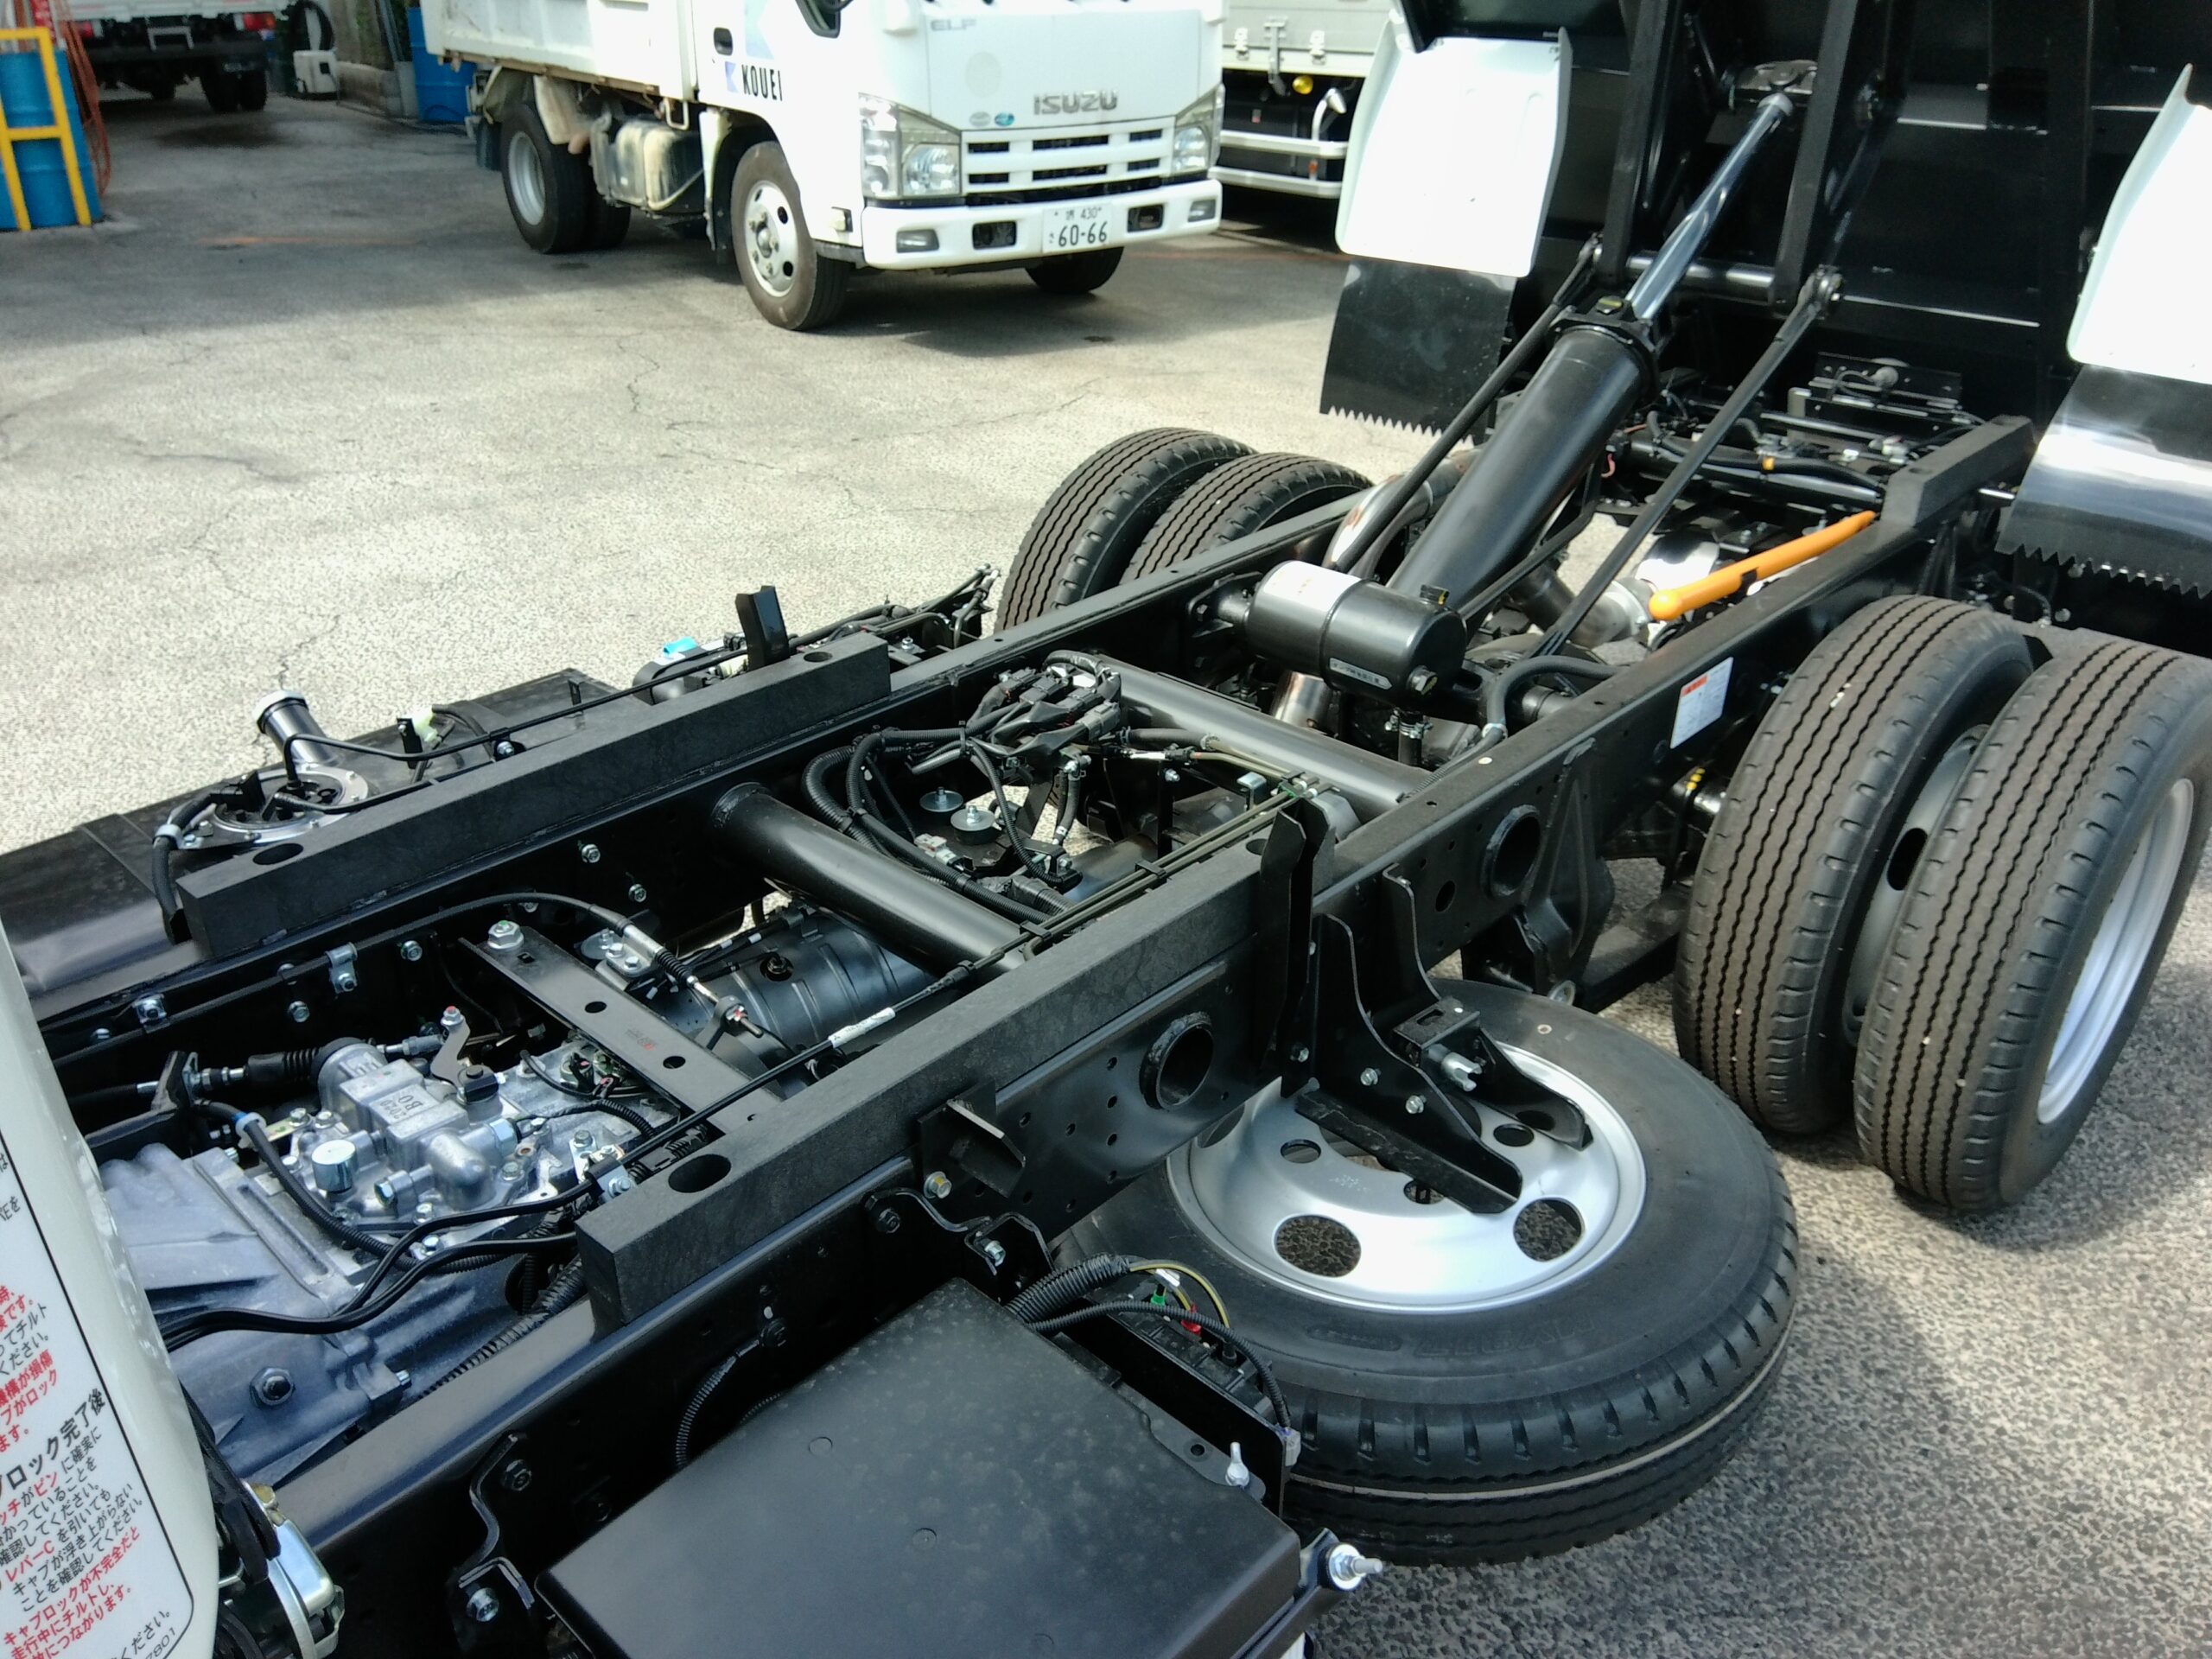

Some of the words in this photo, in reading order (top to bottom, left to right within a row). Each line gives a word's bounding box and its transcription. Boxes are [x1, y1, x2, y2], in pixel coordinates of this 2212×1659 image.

[931, 19, 977, 32] ELF
[741, 64, 783, 102] KOUEI
[1033, 90, 1118, 115] ISUZU
[0, 1456, 97, 1547] かっていることを
